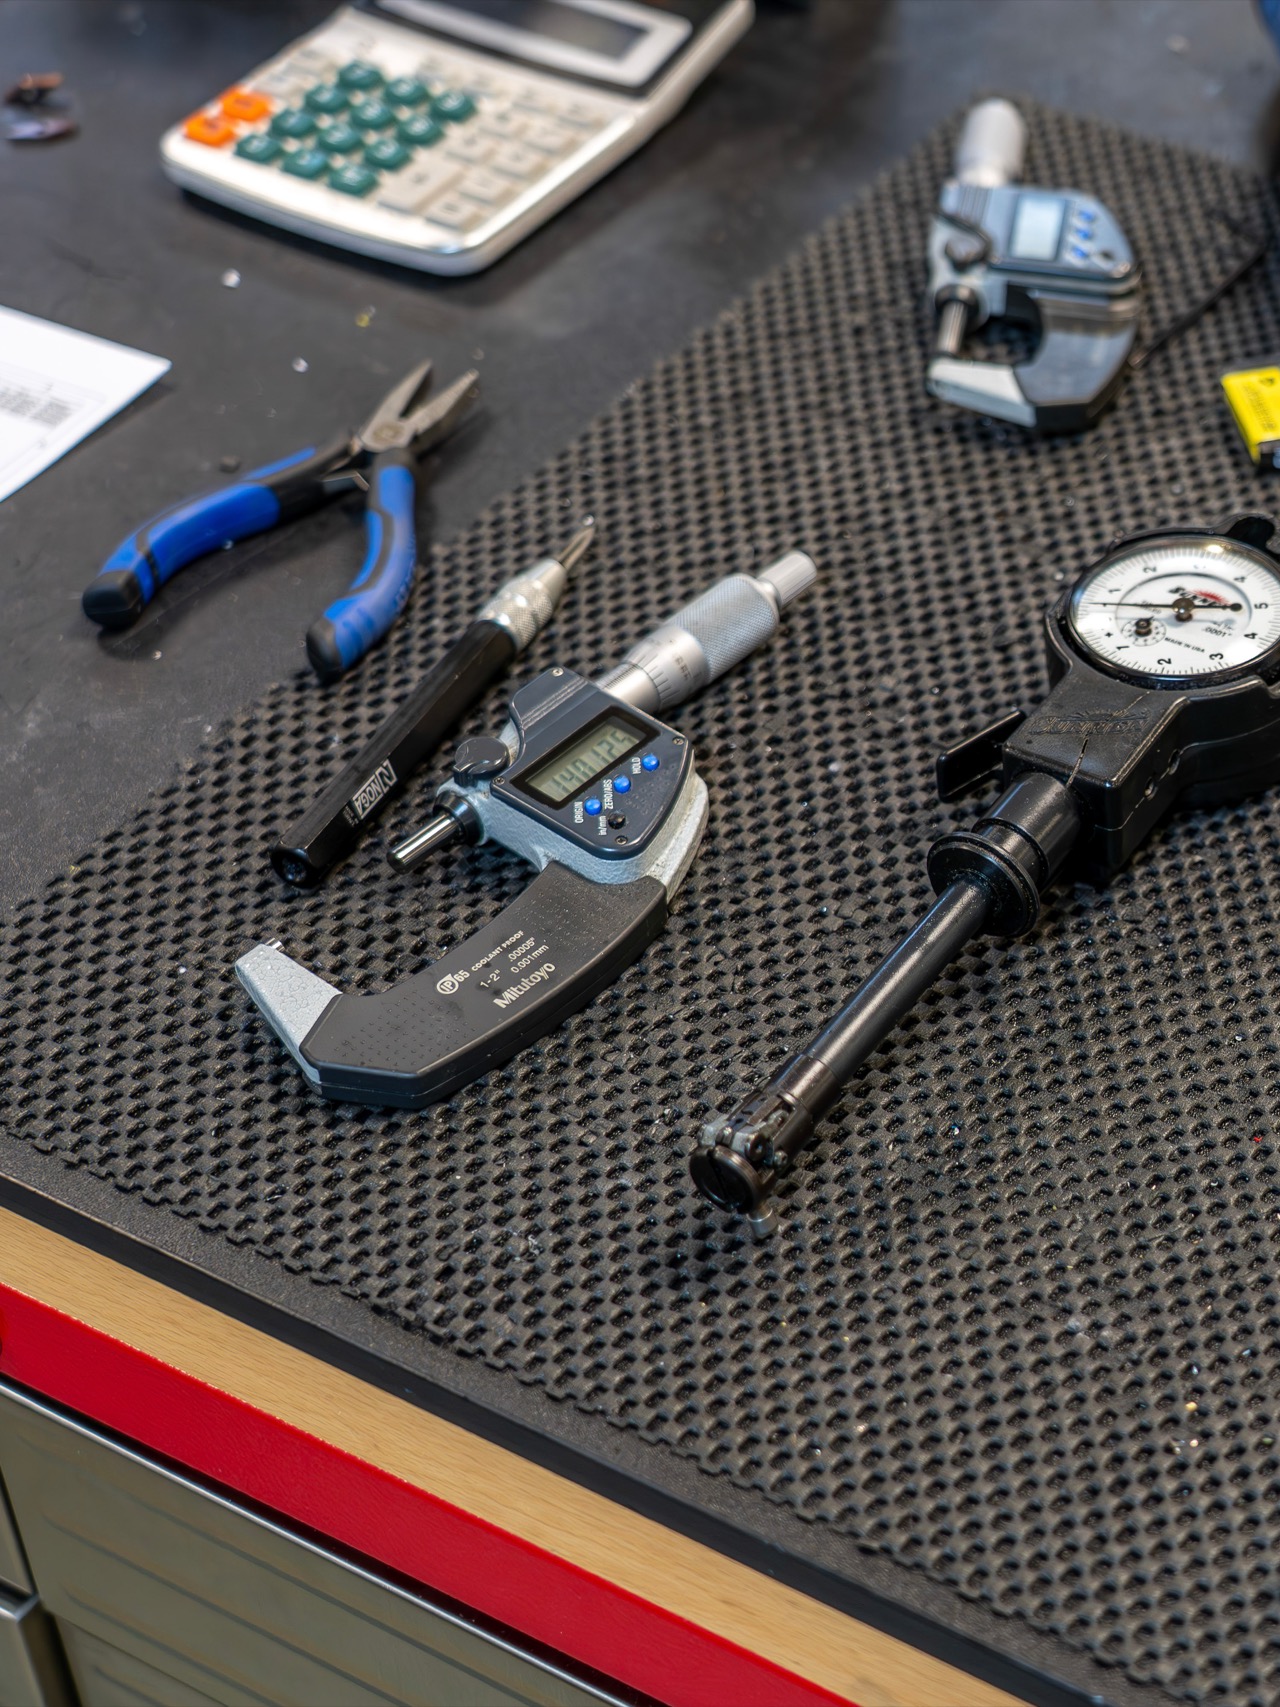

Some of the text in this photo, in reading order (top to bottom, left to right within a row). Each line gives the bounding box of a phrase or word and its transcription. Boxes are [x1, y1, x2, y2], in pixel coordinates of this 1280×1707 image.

[1254, 602, 1268, 610] 5
[1157, 657, 1172, 665] 2
[1209, 652, 1224, 660] 3
[632, 757, 641, 774] HOLD
[354, 778, 382, 814] NOGA
[574, 801, 584, 824] ORIGIN
[471, 946, 503, 972] COOLANT
[503, 930, 525, 949] PROOF
[508, 936, 536, 962] .00005"
[510, 944, 549, 974] 0.001mm
[493, 962, 556, 1009] Mitutoyo
